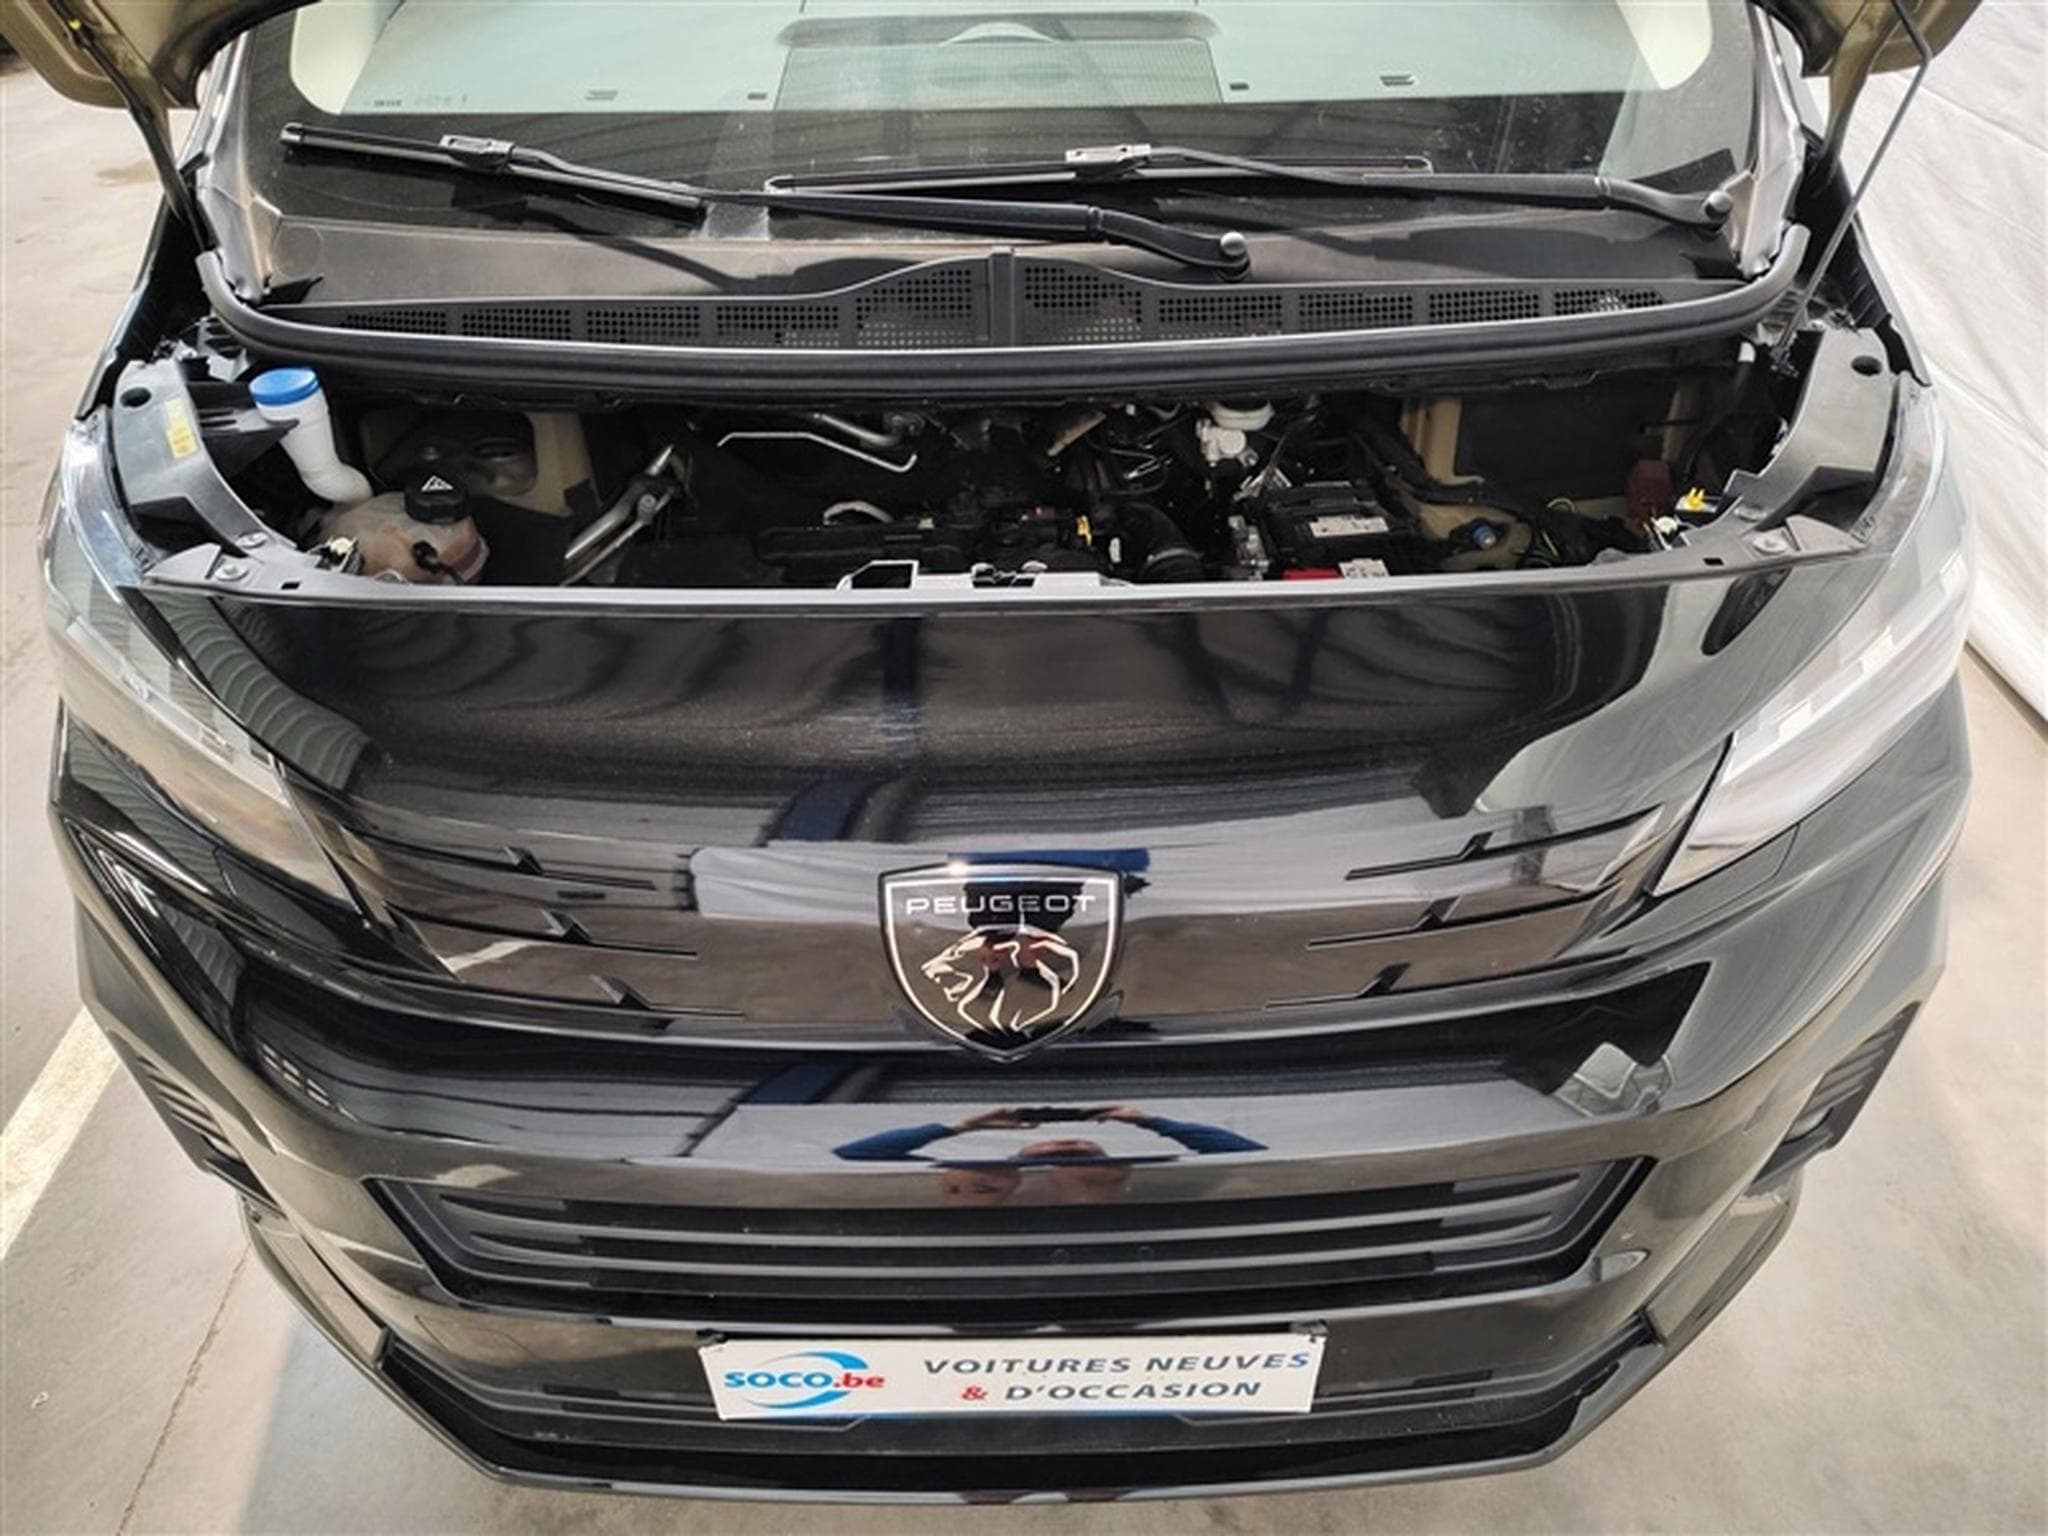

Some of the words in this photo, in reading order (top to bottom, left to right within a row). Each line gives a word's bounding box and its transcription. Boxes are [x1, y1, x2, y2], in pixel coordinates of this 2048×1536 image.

[905, 894, 1096, 915] PEUGEOT
[923, 1357, 1132, 1374] VOITURES
[1145, 1352, 1311, 1372] NEUVES
[961, 1384, 989, 1401] &
[1004, 1382, 1262, 1401] D'OCCASION
